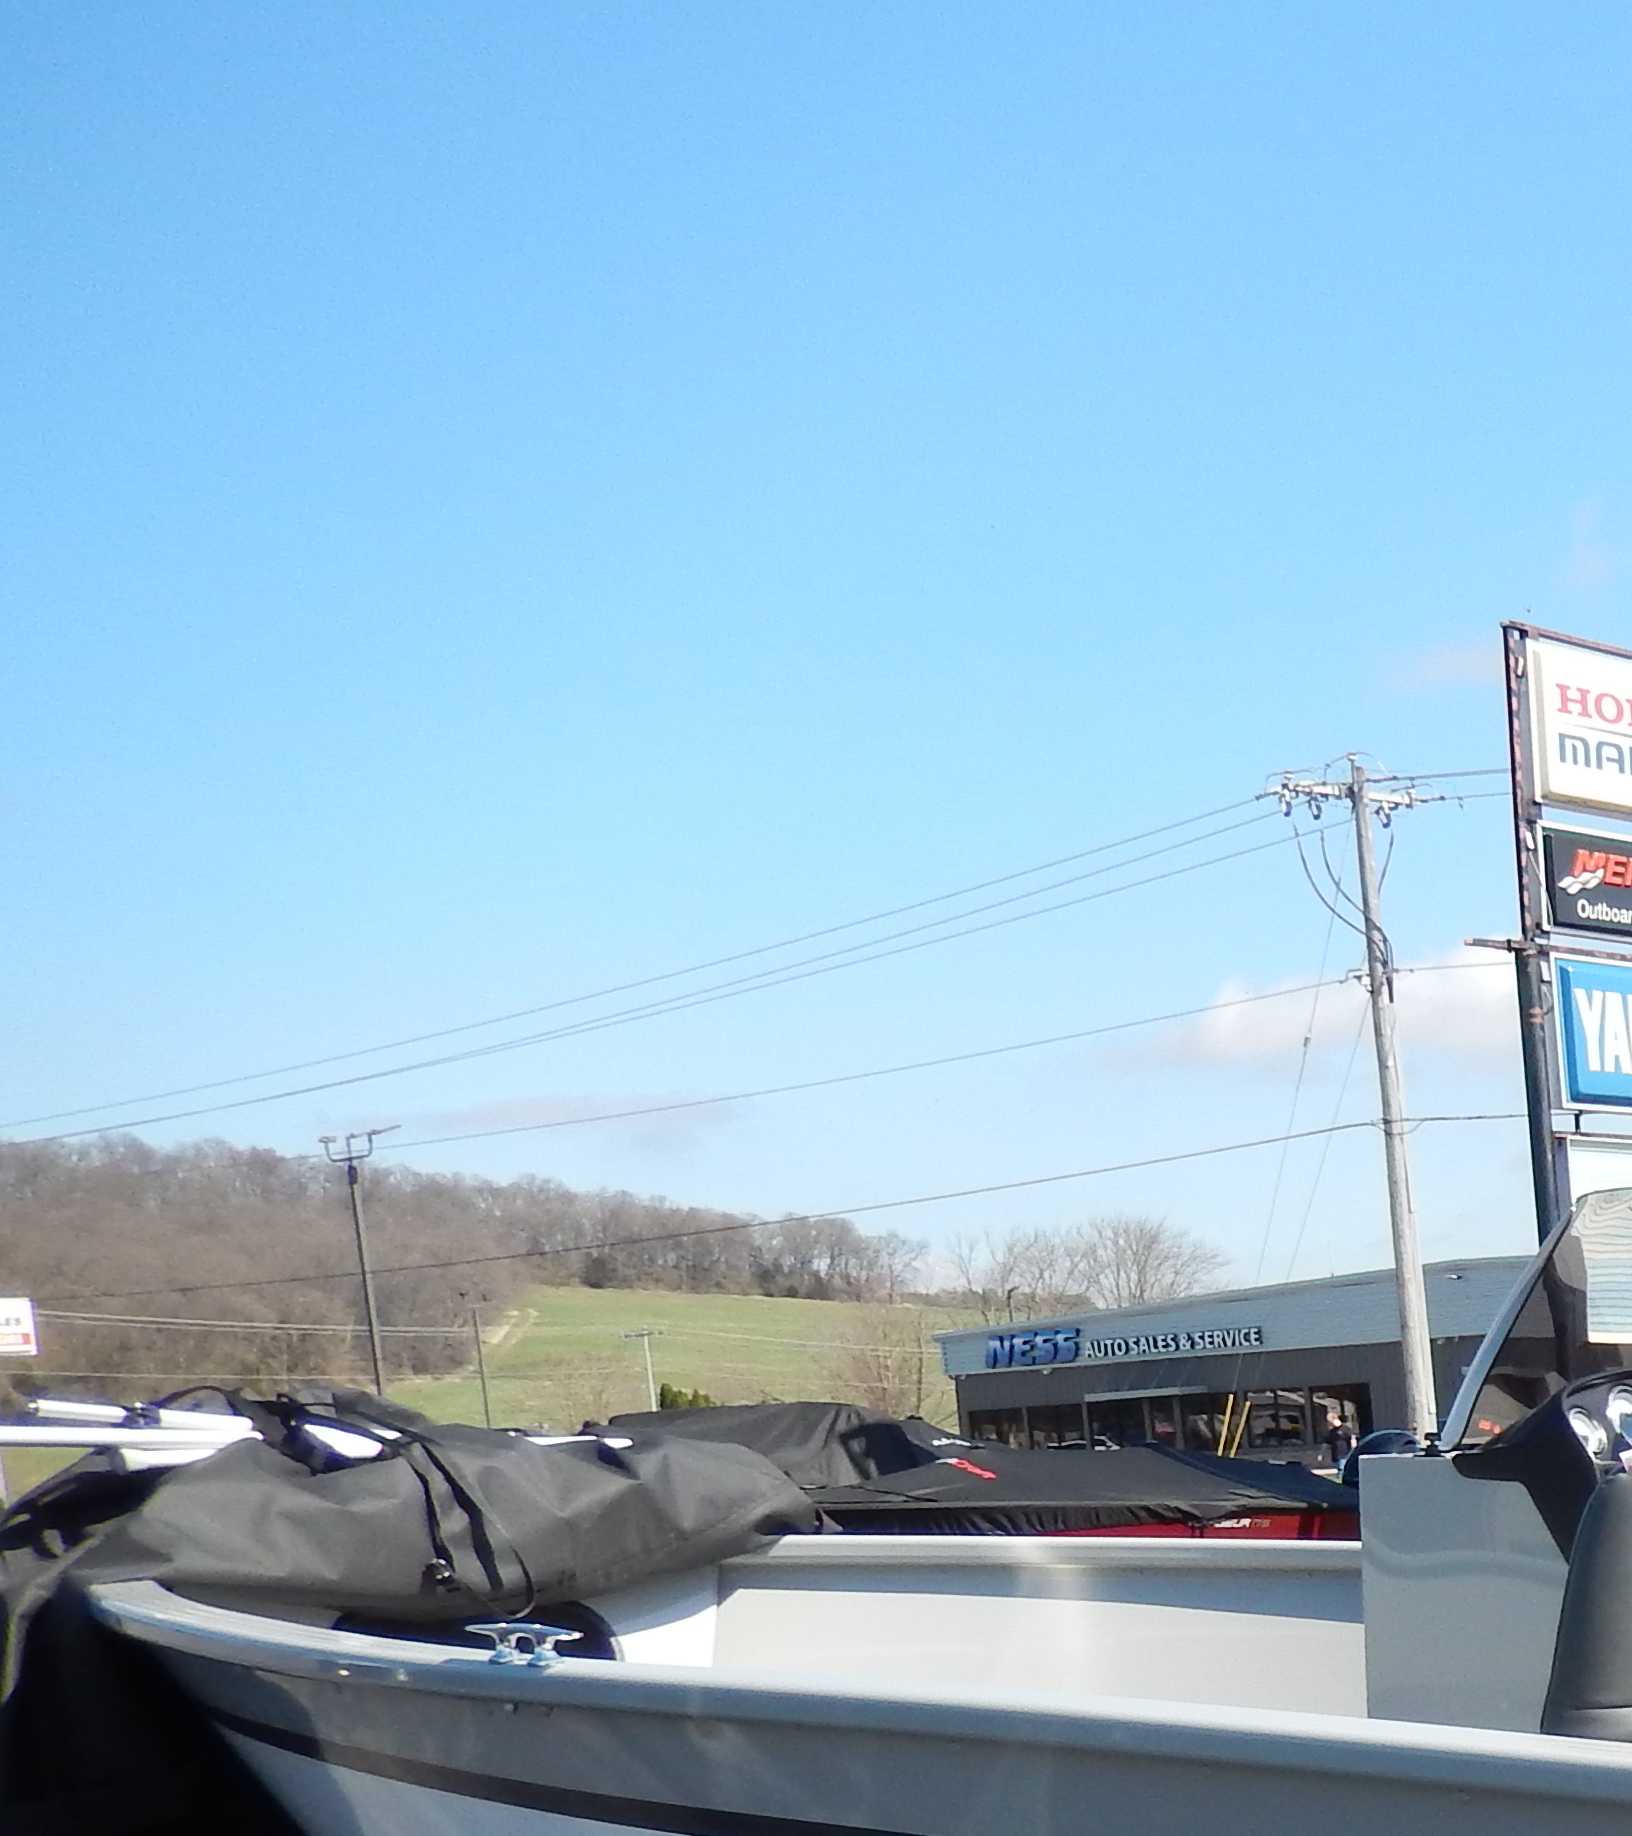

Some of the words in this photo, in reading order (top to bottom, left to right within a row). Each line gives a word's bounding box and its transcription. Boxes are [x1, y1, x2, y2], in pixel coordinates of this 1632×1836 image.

[986, 1327, 1080, 1369] NESS
[1085, 1338, 1127, 1358] AUTO
[1130, 1333, 1176, 1356] SALES
[1179, 1332, 1193, 1351] &
[1195, 1327, 1262, 1350] SERVICE
